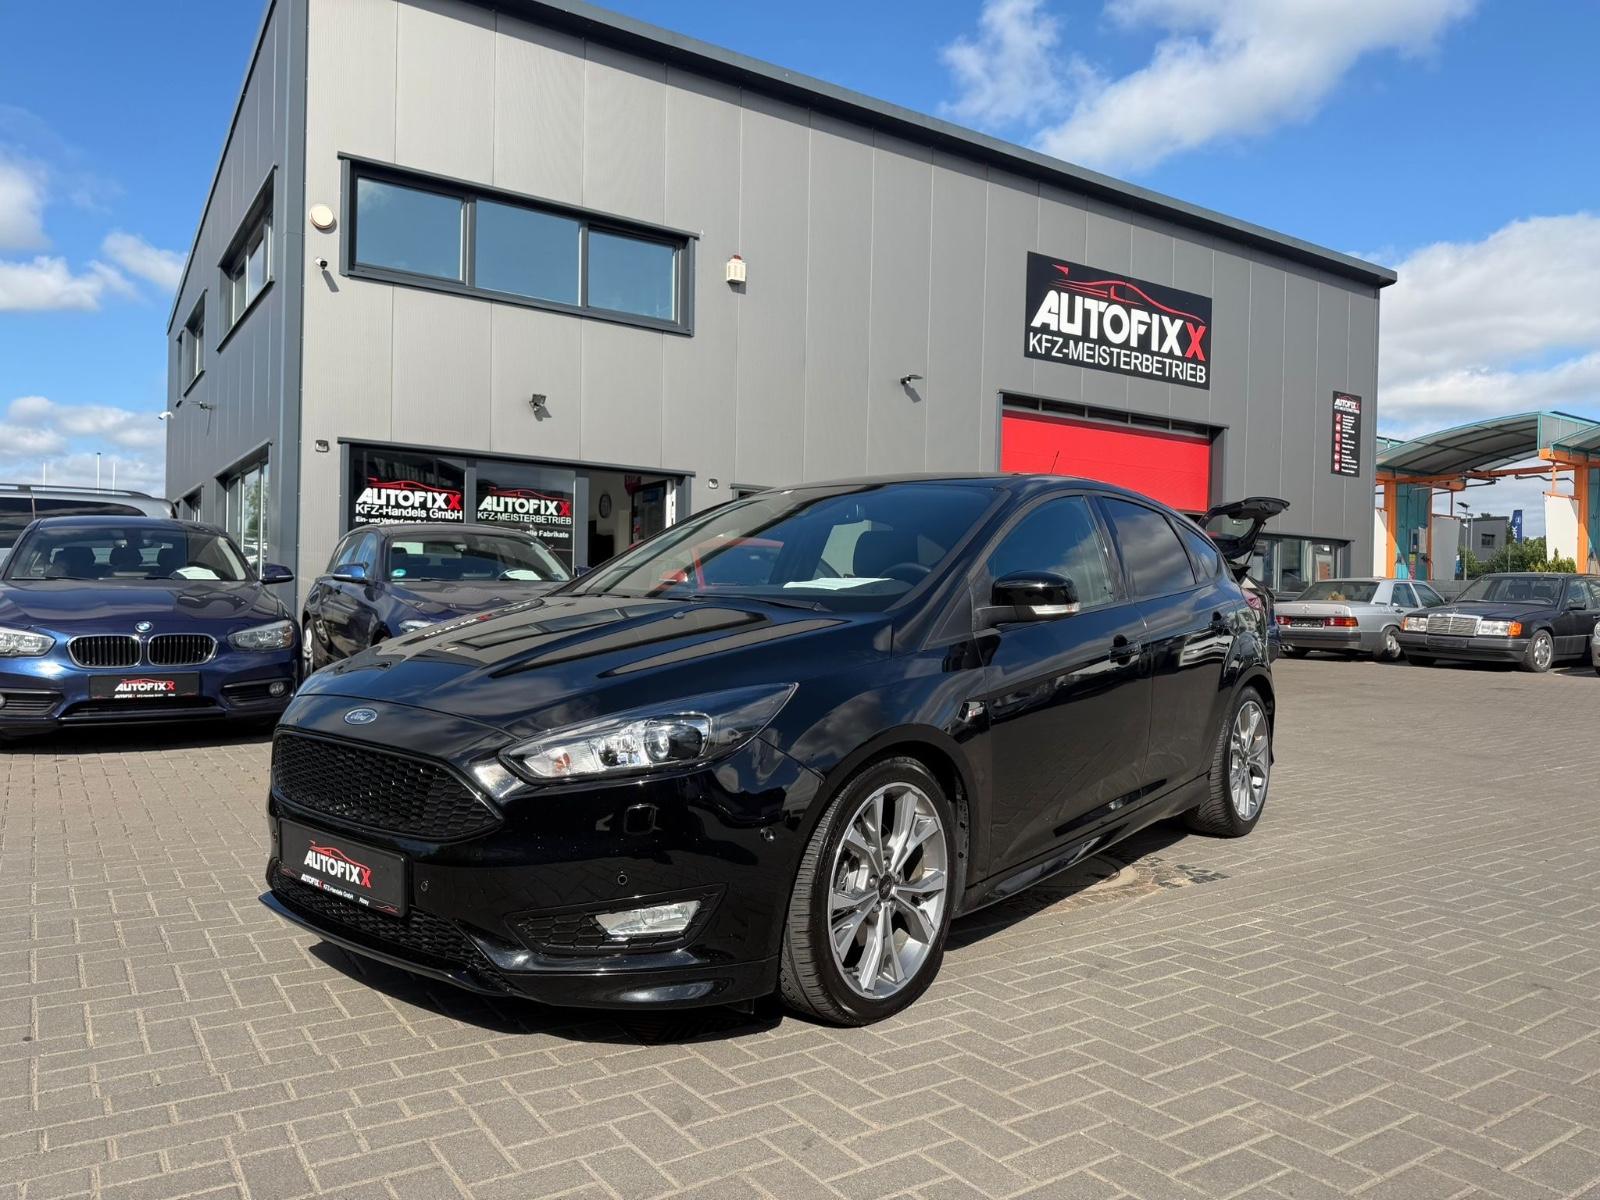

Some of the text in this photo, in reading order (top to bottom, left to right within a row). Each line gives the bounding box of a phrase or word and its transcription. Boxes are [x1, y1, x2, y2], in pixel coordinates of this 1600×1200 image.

[1030, 290, 1207, 362] AUTOFIXX
[1029, 332, 1207, 383] KFZ-MEISTERBETRIEB
[356, 487, 461, 509] AUTOFIXX
[478, 495, 571, 515] AUTOFIXX
[355, 504, 463, 520] KFZ-Handels GmbH
[477, 511, 572, 525] KFZ-MEISTERBETRIEB
[538, 530, 569, 538] Fabrikate
[115, 682, 175, 692] AUTOFIXX
[304, 850, 371, 888] AUTOFIXX
